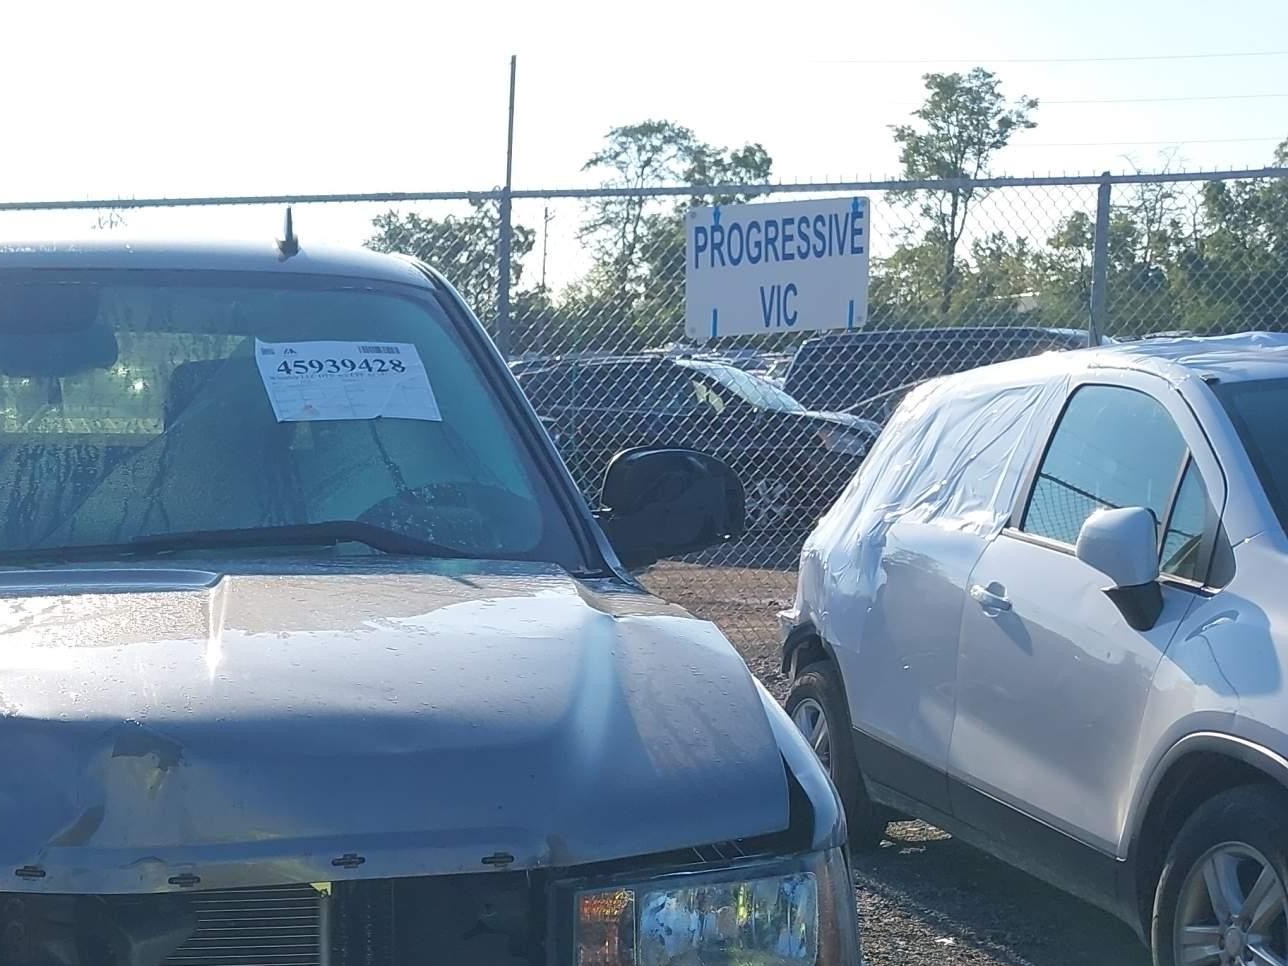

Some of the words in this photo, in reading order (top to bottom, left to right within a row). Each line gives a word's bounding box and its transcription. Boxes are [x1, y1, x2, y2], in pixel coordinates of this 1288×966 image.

[694, 211, 864, 269] PROGRESSIVE
[759, 283, 799, 328] VIC
[276, 358, 407, 375] 45939428
